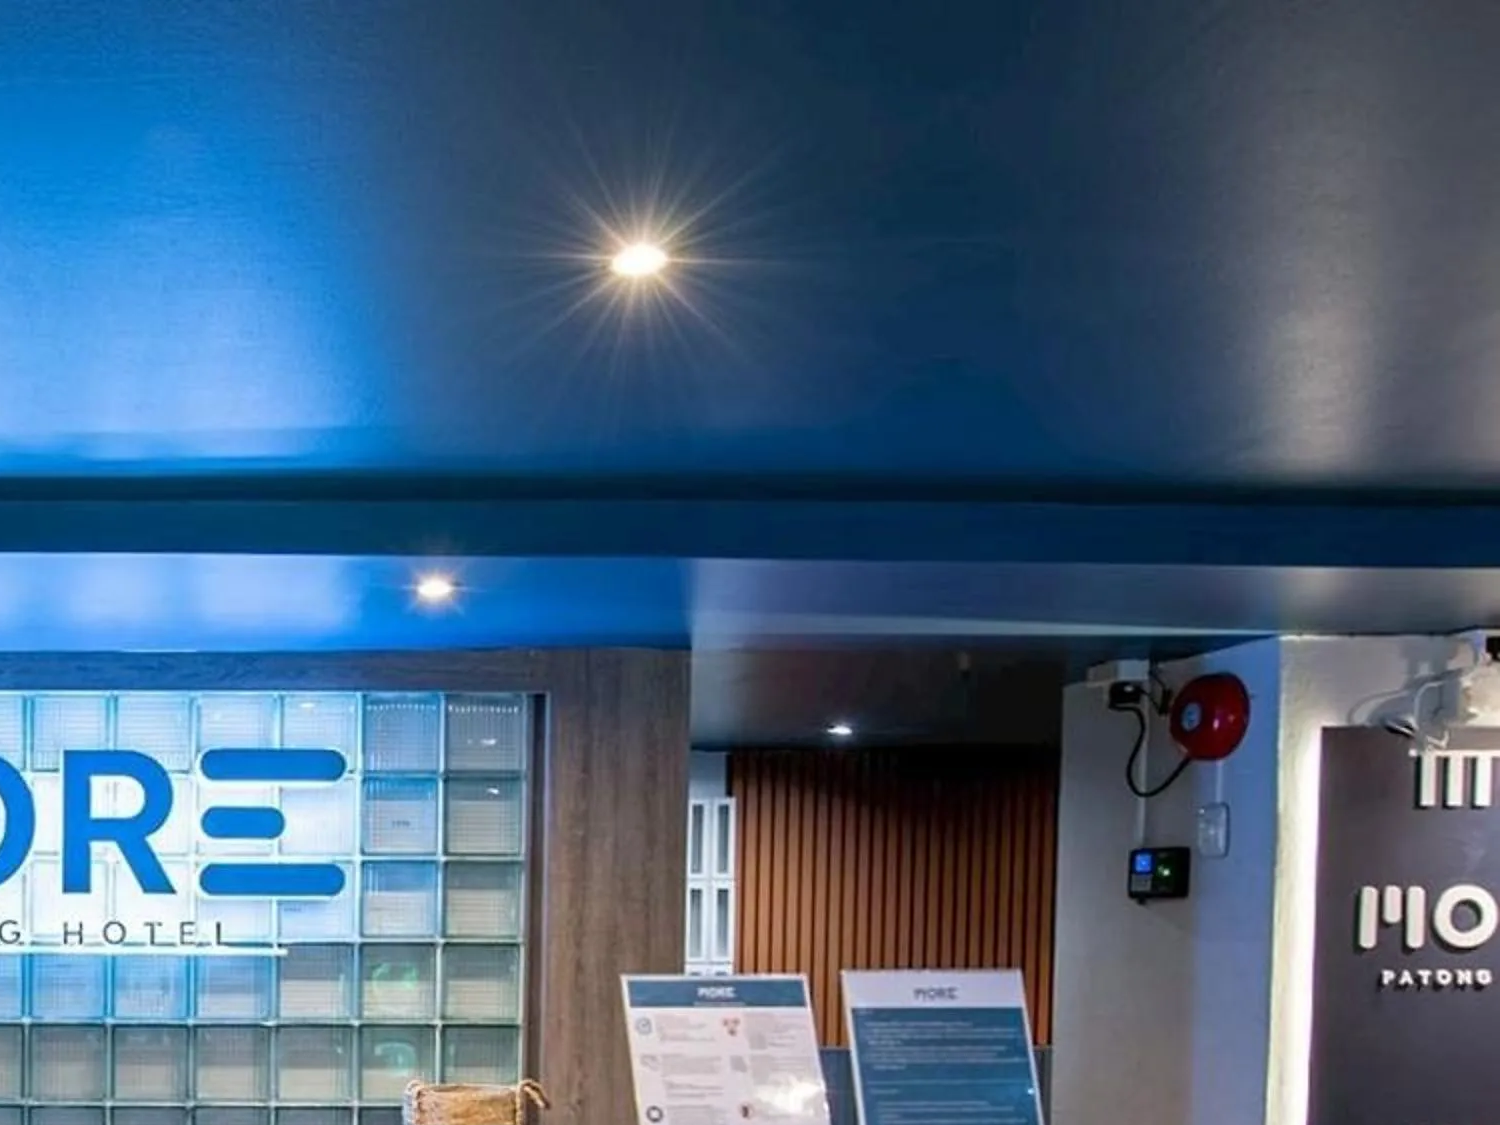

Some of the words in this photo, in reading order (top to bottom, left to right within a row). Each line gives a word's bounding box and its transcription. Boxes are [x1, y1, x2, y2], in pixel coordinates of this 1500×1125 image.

[62, 919, 228, 947] HOTEL
[1381, 968, 1493, 986] PATONG
[912, 986, 960, 1001] MORE
